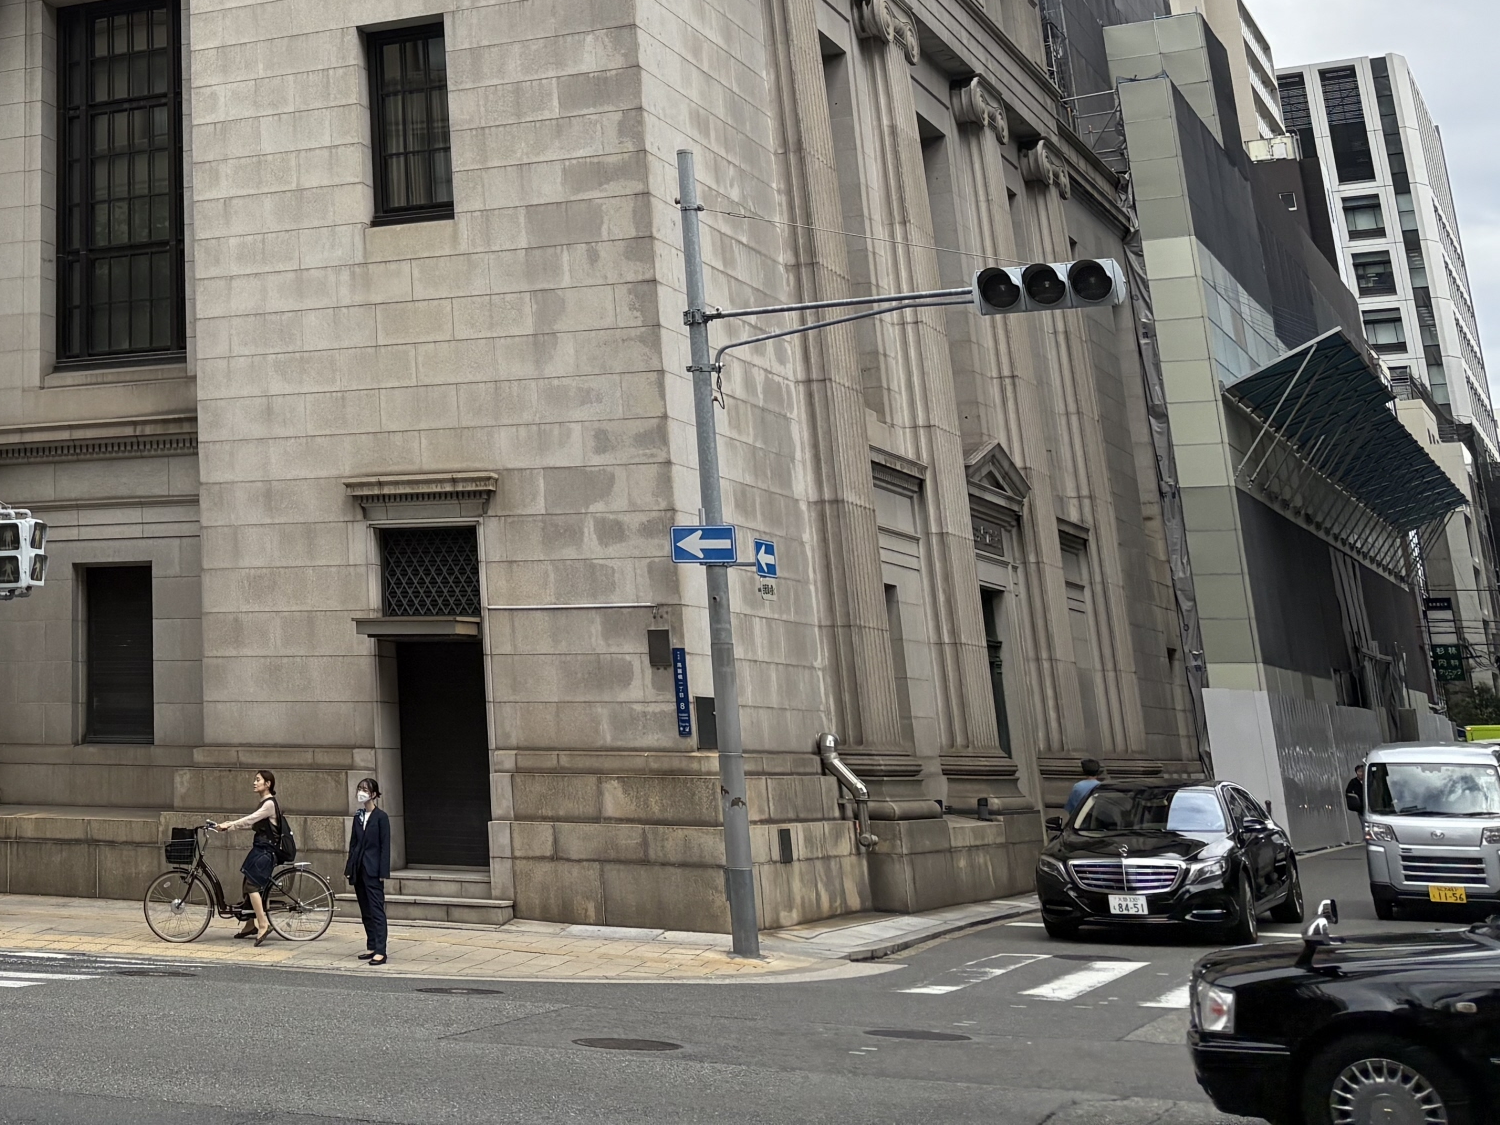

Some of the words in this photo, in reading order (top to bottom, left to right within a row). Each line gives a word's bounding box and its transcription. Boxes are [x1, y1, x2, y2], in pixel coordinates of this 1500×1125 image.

[680, 702, 685, 710] 8
[1438, 891, 1465, 902] 11-56
[1118, 902, 1145, 913] 84-51
